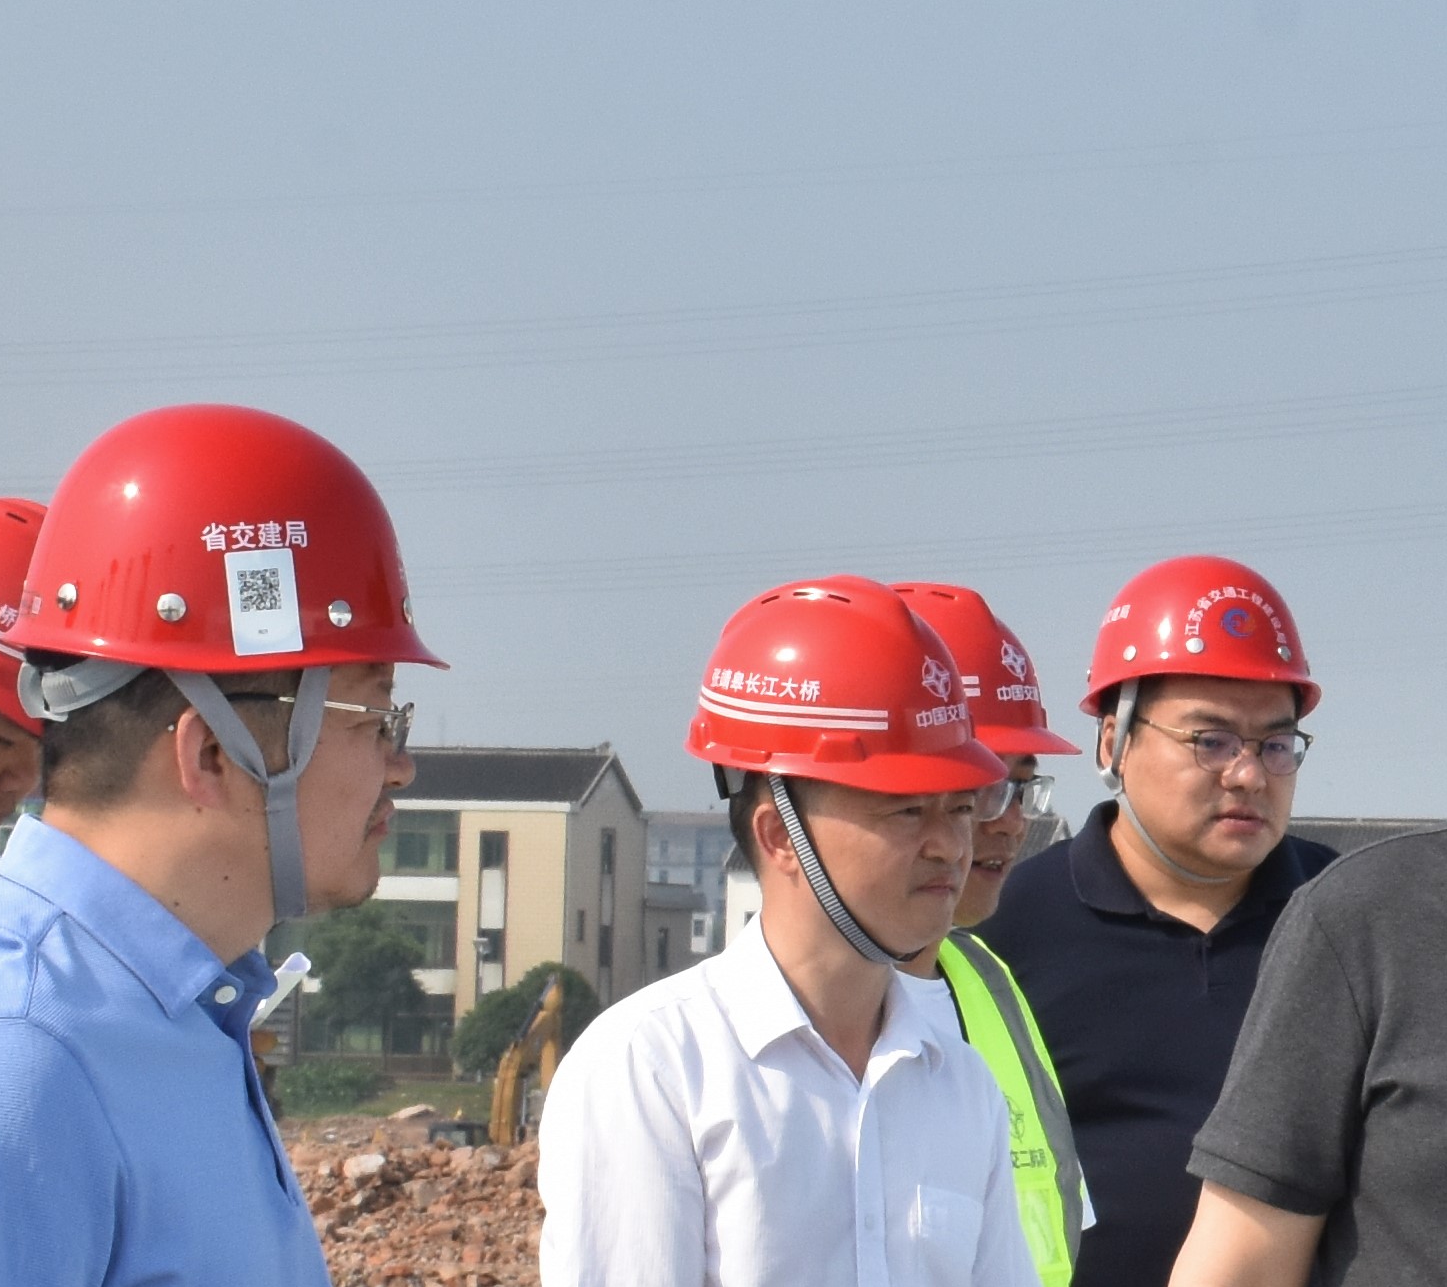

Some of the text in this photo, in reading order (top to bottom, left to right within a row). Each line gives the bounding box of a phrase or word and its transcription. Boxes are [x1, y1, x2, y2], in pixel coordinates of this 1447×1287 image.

[200, 520, 308, 552] 省交建局
[710, 667, 820, 702] 张靖皋长江大桥
